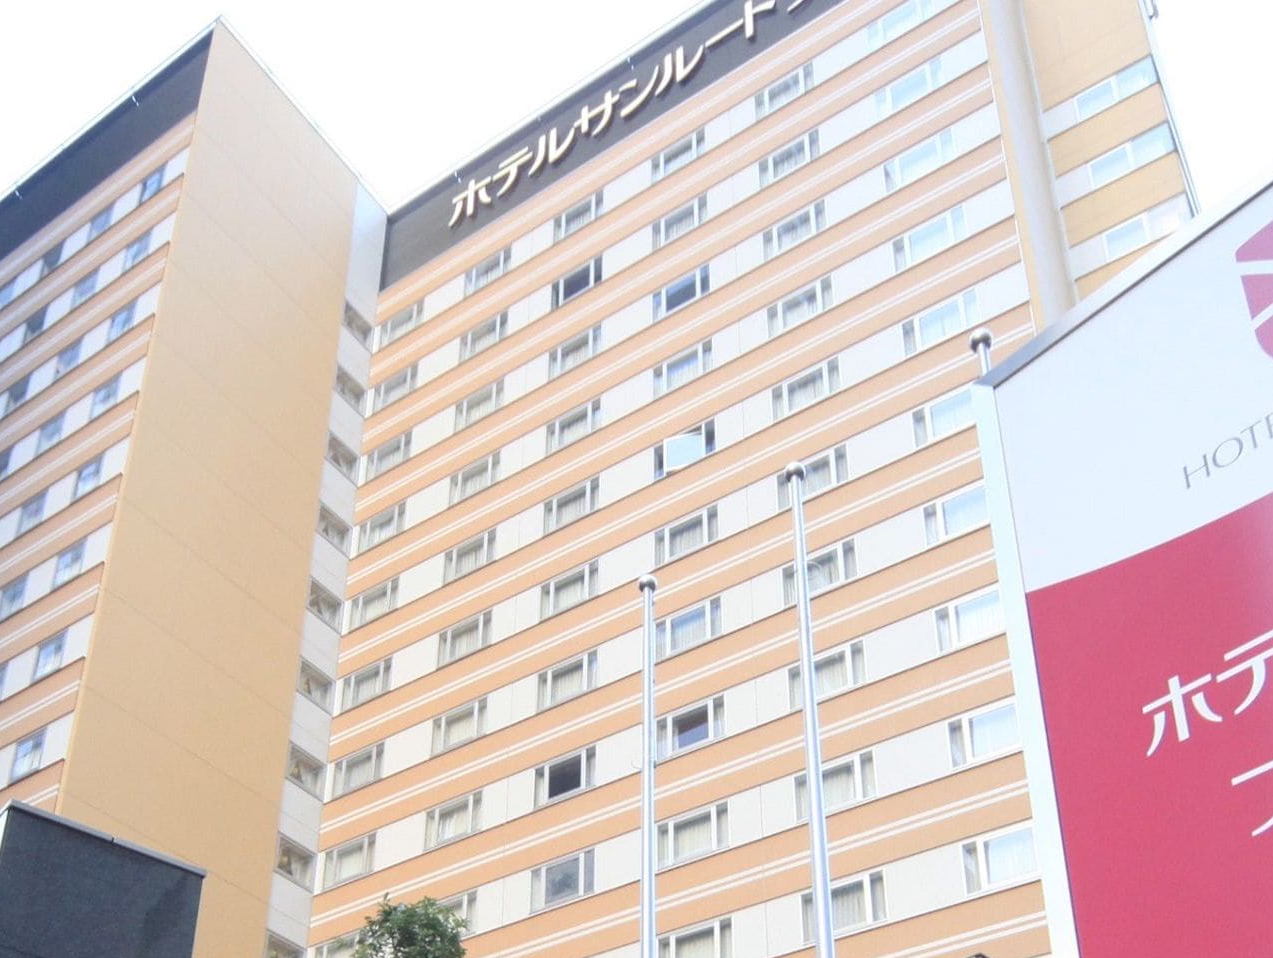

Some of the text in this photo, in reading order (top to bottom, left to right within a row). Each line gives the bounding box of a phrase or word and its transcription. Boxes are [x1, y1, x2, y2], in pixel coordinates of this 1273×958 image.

[448, 0, 804, 227] ホテルサンルート
